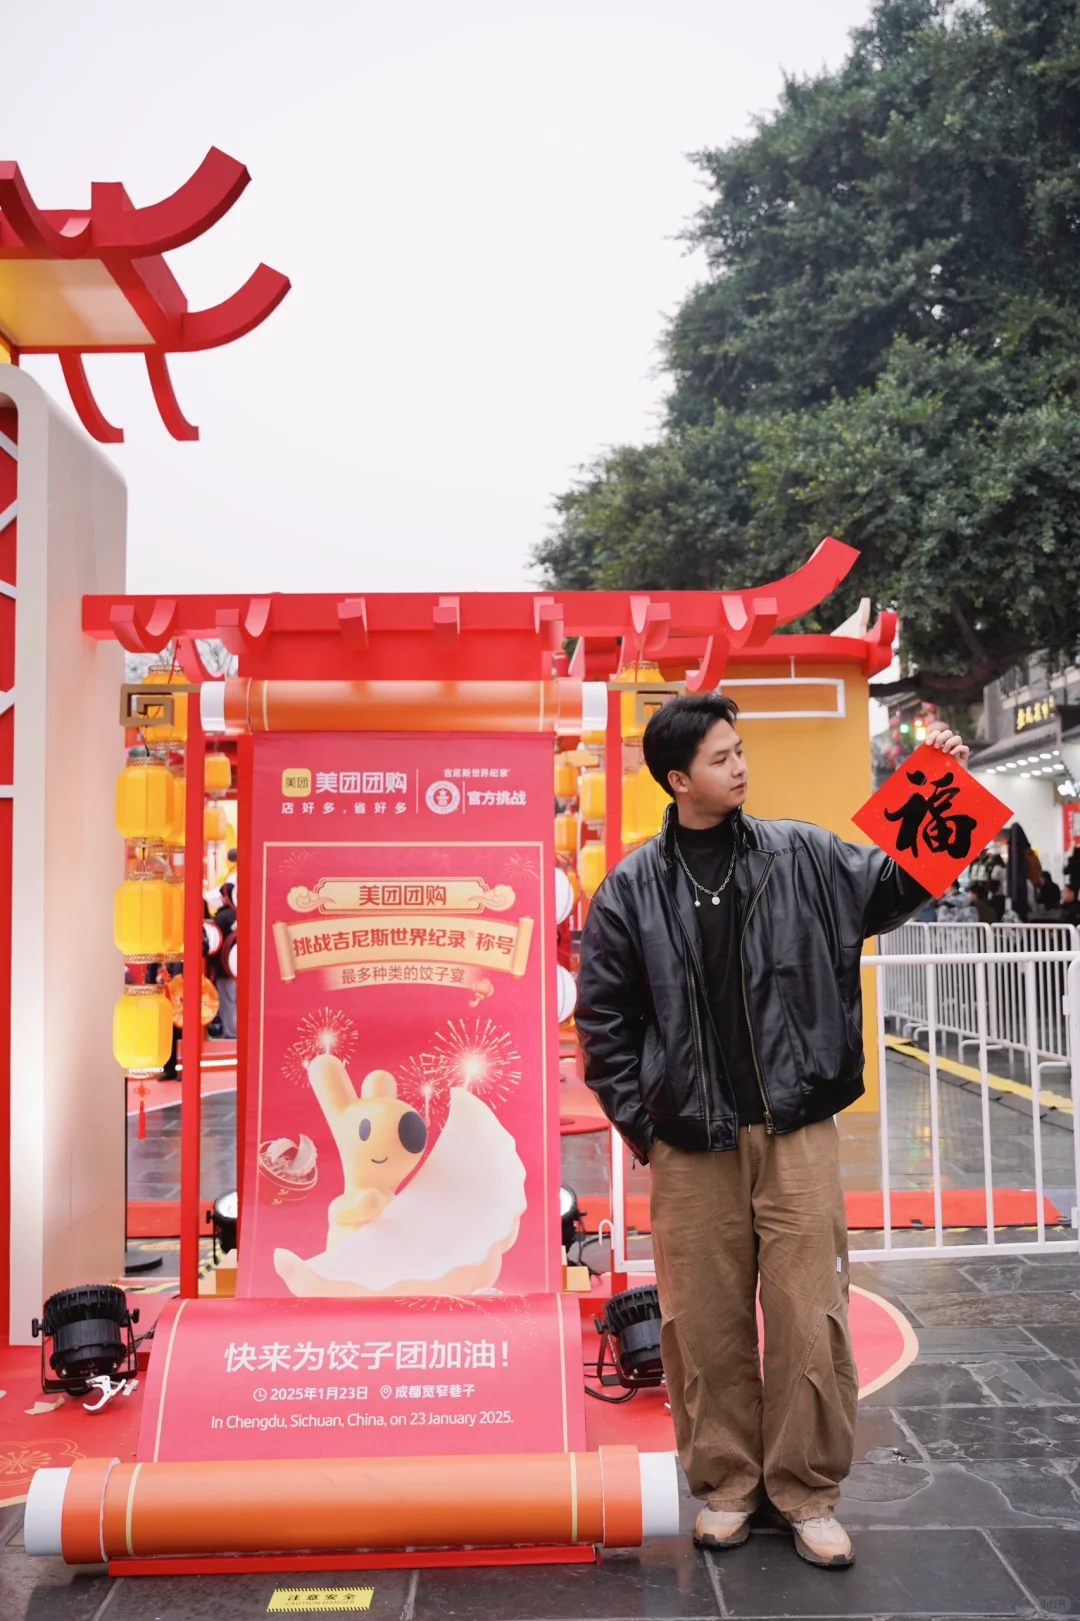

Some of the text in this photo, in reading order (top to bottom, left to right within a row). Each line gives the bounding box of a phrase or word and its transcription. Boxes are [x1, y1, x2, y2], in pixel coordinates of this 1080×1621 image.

[285, 776, 309, 789] 美团
[315, 771, 408, 794] 美团团购
[466, 789, 527, 806] 官方挑战
[884, 770, 977, 860] 福
[358, 885, 447, 906] 美团团购
[341, 965, 466, 985] 最多种类的饺子宴
[224, 1339, 509, 1373] 快来为饺子团加油！
[270, 1384, 476, 1400] 2025年1月23日 成都宽窄巷子
[211, 1411, 514, 1431] In Chengdu, Sichuan, China, on 23 January 2025.
